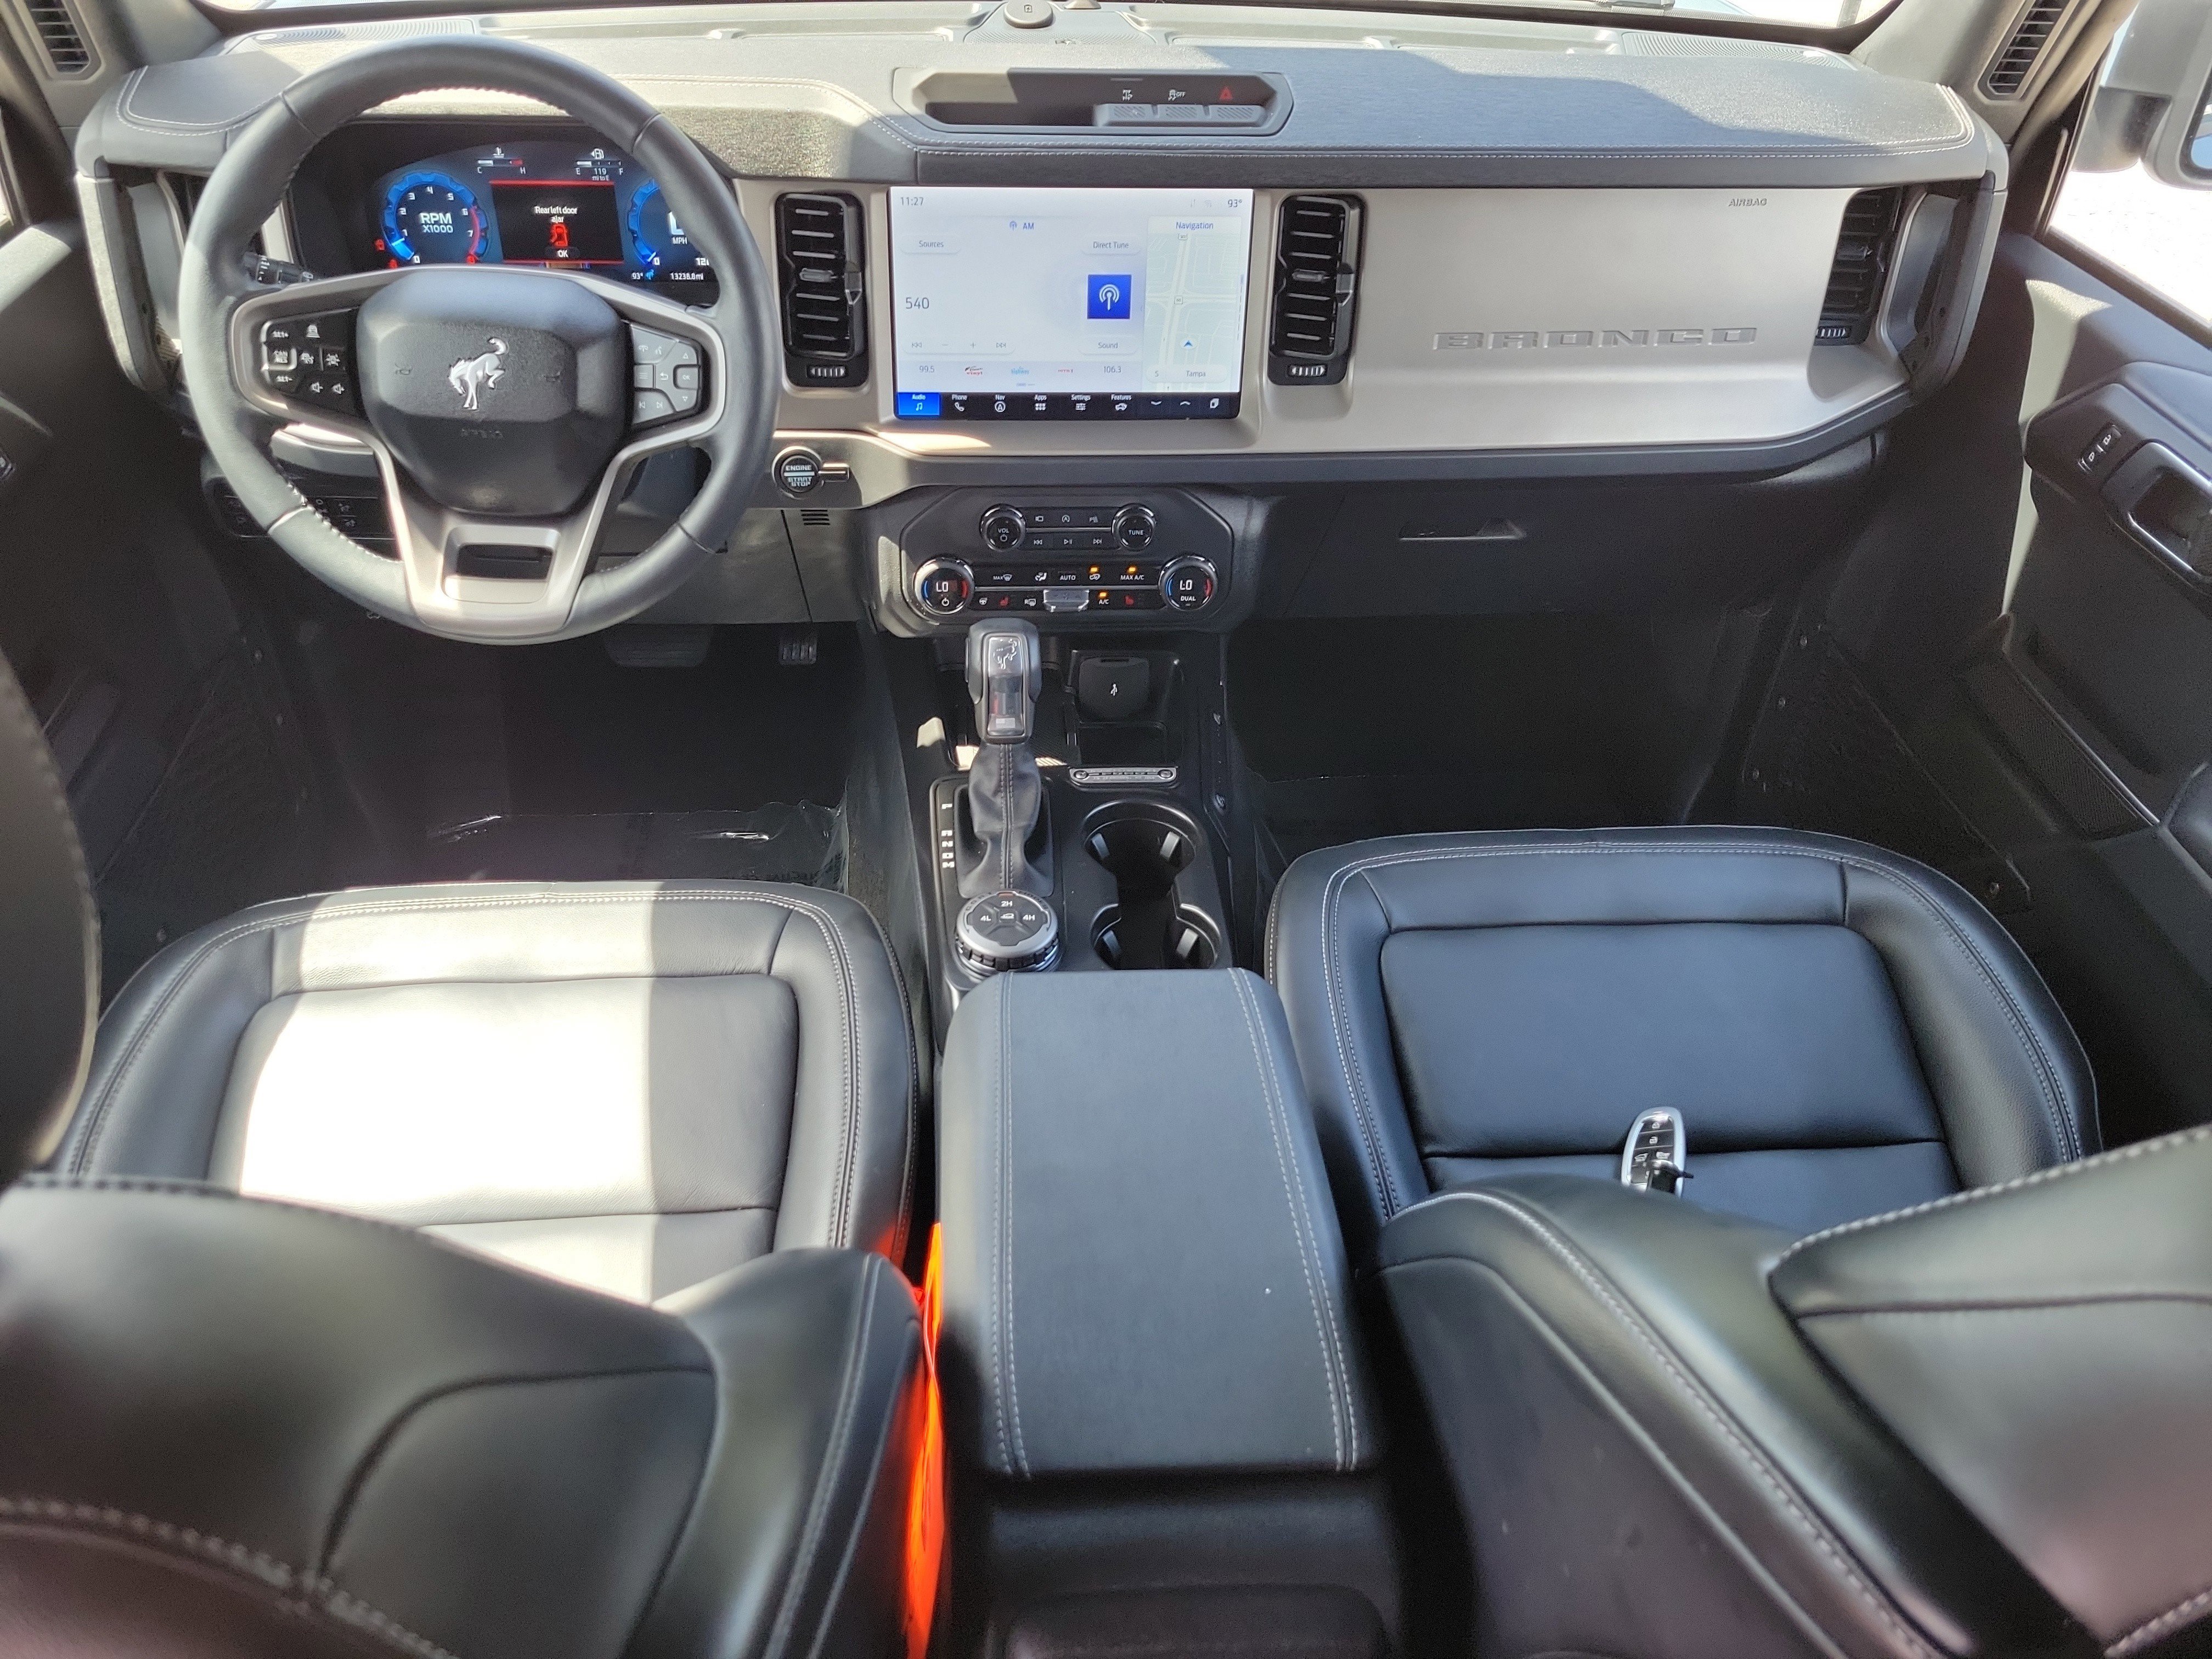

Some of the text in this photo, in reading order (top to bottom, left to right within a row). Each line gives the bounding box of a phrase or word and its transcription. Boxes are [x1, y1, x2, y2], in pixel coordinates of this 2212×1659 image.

[619, 167, 624, 176] F
[900, 196, 924, 206] 11:27
[1728, 198, 1767, 207] AIRBAG
[534, 206, 578, 215] Rear left door
[419, 212, 452, 224] RPM
[551, 215, 564, 224] ajar
[422, 224, 454, 233] X1000
[1176, 222, 1214, 230] Navigation
[557, 250, 568, 258] OK
[414, 255, 421, 263] 0
[653, 257, 660, 266] 0
[905, 297, 930, 309] 540
[1432, 327, 1757, 349] BRONCO
[935, 581, 949, 592] LO
[1180, 579, 1192, 591] LO
